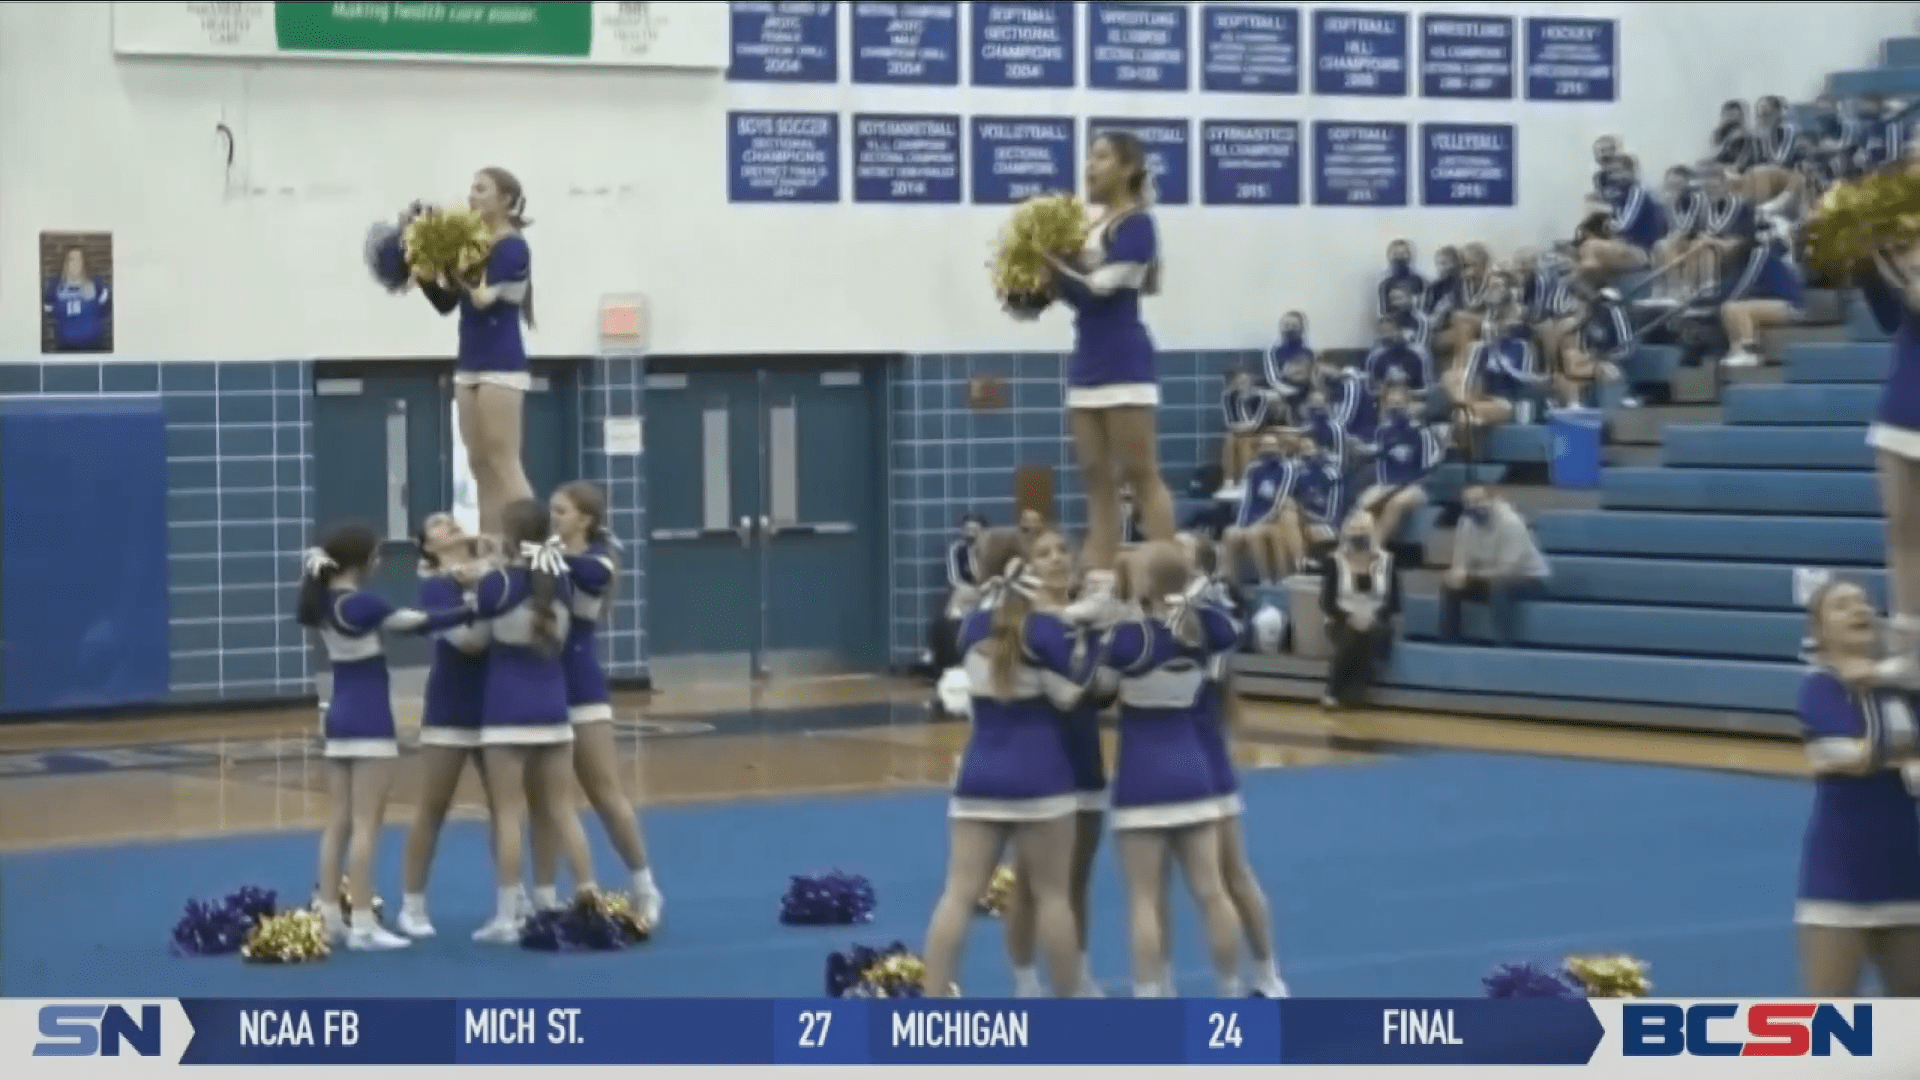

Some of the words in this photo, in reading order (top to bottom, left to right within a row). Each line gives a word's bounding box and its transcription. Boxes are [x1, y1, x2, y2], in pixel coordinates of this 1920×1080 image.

[738, 116, 773, 136] BOYS
[776, 117, 828, 136] SOCCER
[979, 123, 1066, 140] VOLLEYBALL
[743, 149, 825, 163] CHAMPIONS
